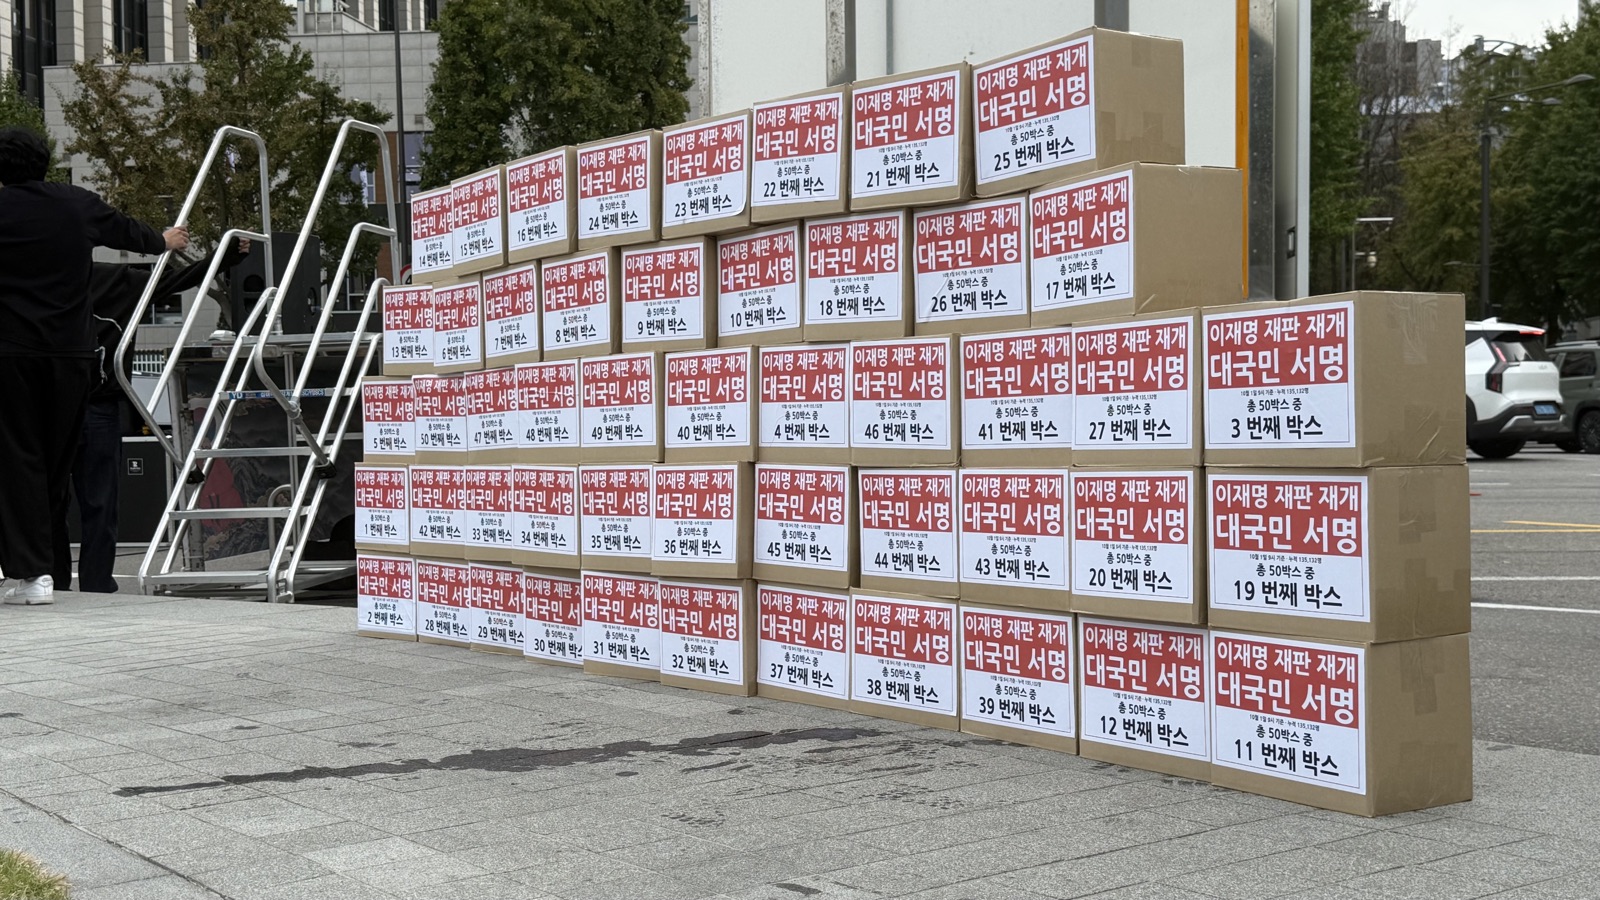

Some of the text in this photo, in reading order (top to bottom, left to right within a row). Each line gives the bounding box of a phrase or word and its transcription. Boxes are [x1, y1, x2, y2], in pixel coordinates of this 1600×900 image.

[979, 44, 1086, 93] 이재명 재판 재개
[980, 71, 1085, 126] 대국민 서명
[1010, 124, 1054, 145] 총 50박스 중
[994, 136, 1075, 171] 25 번째 박스
[763, 176, 824, 197] 22 번째 박스
[1034, 179, 1127, 220] 이재명 재판 재개
[517, 221, 557, 241] 16 번째 박스
[588, 210, 638, 230] 24 번째 박스
[1034, 207, 1126, 254] 대국민 서명
[1059, 258, 1098, 275] 총 50박스 중
[1046, 271, 1115, 300] 17 번째 박스
[730, 306, 786, 327] 10 번째 박스
[555, 324, 596, 342] 8 번째 박스
[1210, 311, 1344, 346] 이재명 재판 재개
[391, 344, 427, 358] 13 번째 박스
[1077, 325, 1185, 356] 이재명 재판 재개
[1077, 353, 1184, 392] 대국민 서명
[1210, 343, 1343, 386] 대국민 서명
[1106, 402, 1151, 416] 총 50박스 중
[1246, 397, 1302, 412] 총 50박스 중
[591, 423, 643, 440] 49 번째 박스
[774, 423, 829, 441] 4 번째 박스
[1089, 418, 1171, 441] 27 번째 박스
[1231, 414, 1323, 439] 3 번째 박스
[373, 437, 406, 450] 5 번째 박스
[1076, 479, 1185, 503] 이재명 재판 재개
[1215, 483, 1358, 511] 이재명 재판 재개
[364, 523, 397, 537] 1 번째 박스
[1076, 506, 1184, 542] 대국민 서명
[1216, 512, 1357, 554] 대국민 서명
[591, 534, 641, 551] 35 번째 박스
[767, 541, 831, 562] 45 번째 박스
[1106, 551, 1151, 566] 총 50박스 중
[1089, 567, 1172, 592] 20 번째 박스
[1256, 562, 1315, 580] 총 50박스 중
[1234, 580, 1342, 609] 19 번째 박스
[367, 611, 403, 625] 2 번째 박스
[1085, 626, 1201, 661] 이재명 재판 재개
[672, 653, 729, 675] 32 번째 박스
[1217, 641, 1355, 683] 이재명 재판 재개
[1086, 653, 1200, 699] 대국민 서명
[1217, 671, 1353, 724] 대국민 서명
[1118, 701, 1166, 720] 총 50박스 중
[1100, 715, 1189, 747] 12 번째 박스
[1255, 724, 1312, 746] 총 50박스 중
[1234, 738, 1339, 776] 11 번째 박스
